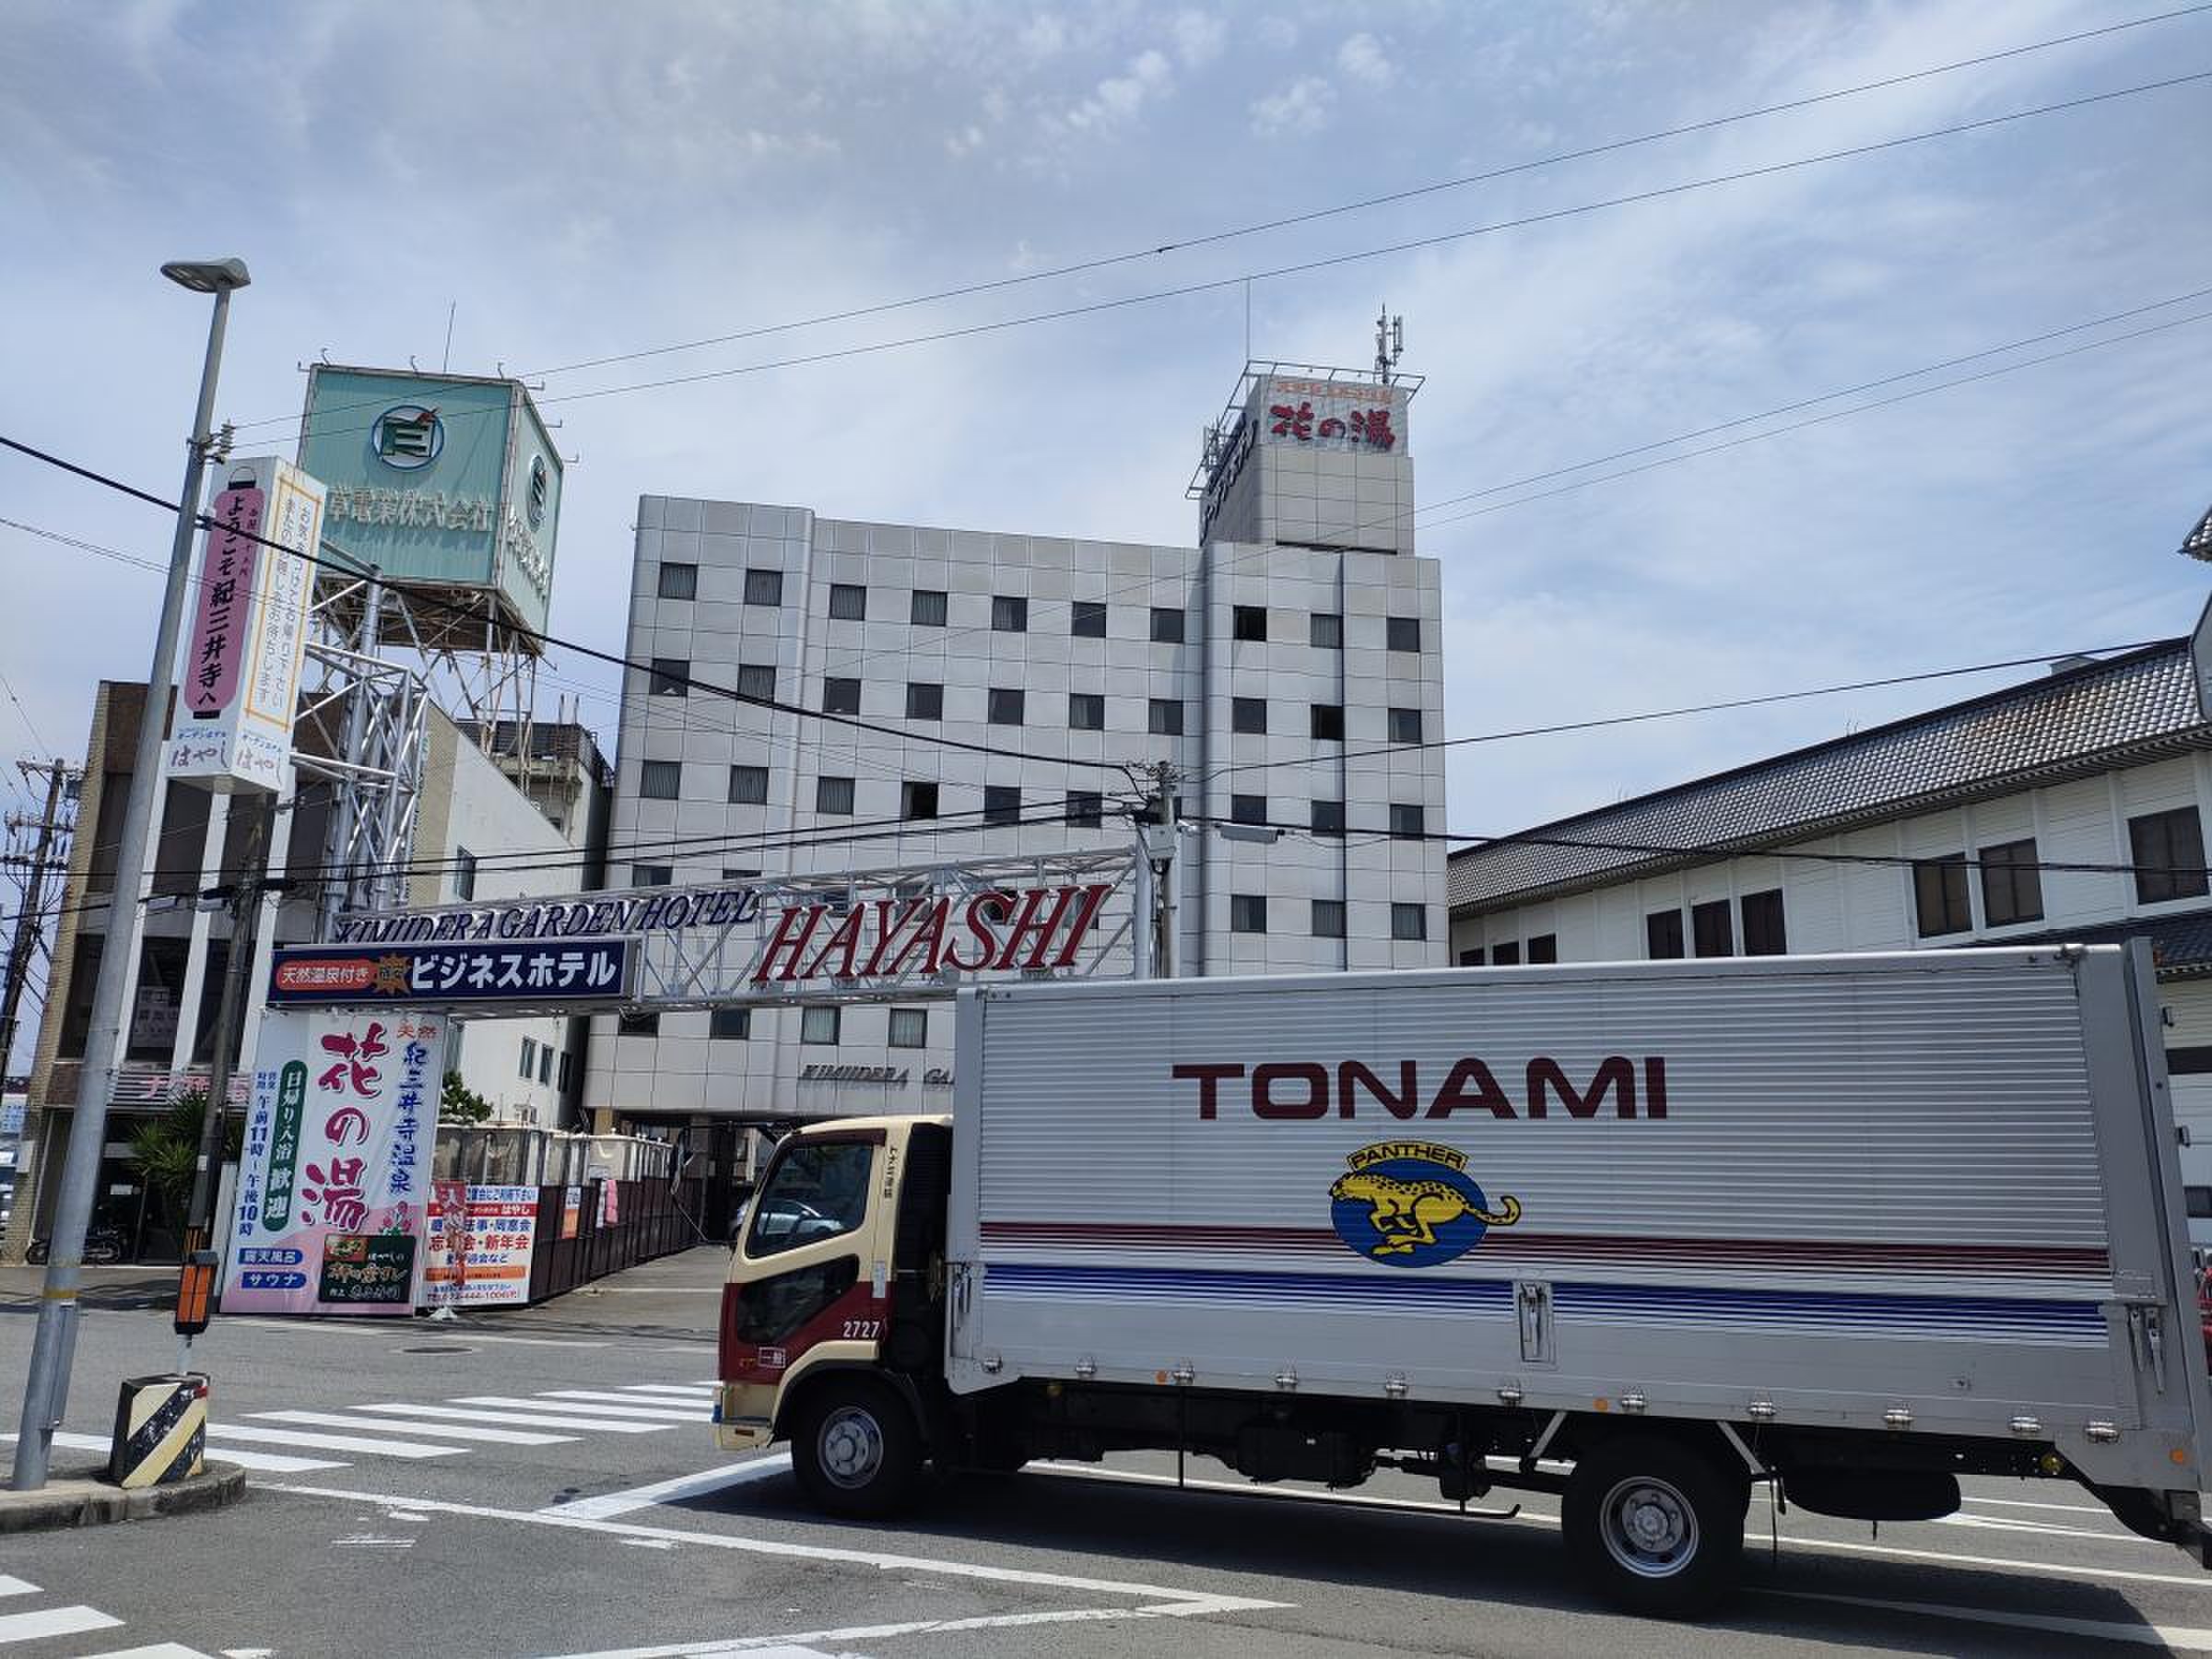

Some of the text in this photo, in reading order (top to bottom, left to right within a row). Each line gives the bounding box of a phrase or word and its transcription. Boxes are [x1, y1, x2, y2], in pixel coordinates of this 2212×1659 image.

[1269, 402, 1396, 452] 花の湯
[500, 900, 636, 939] GARDEN
[639, 888, 760, 931] HOTEL
[751, 883, 1113, 983] HAYASHI
[281, 966, 370, 984] 天然温泉付き
[412, 951, 616, 990] ビジネスホテル
[799, 1064, 956, 1085] KIMIIDERA GA
[1172, 1056, 1666, 1120] TONAMI
[301, 1022, 389, 1230] 花の湯
[390, 1041, 428, 1195] 紀三井寺温泉
[1351, 1144, 1465, 1171] PANTHER
[249, 1273, 299, 1286] サウナ
[843, 1321, 880, 1337] 2727
